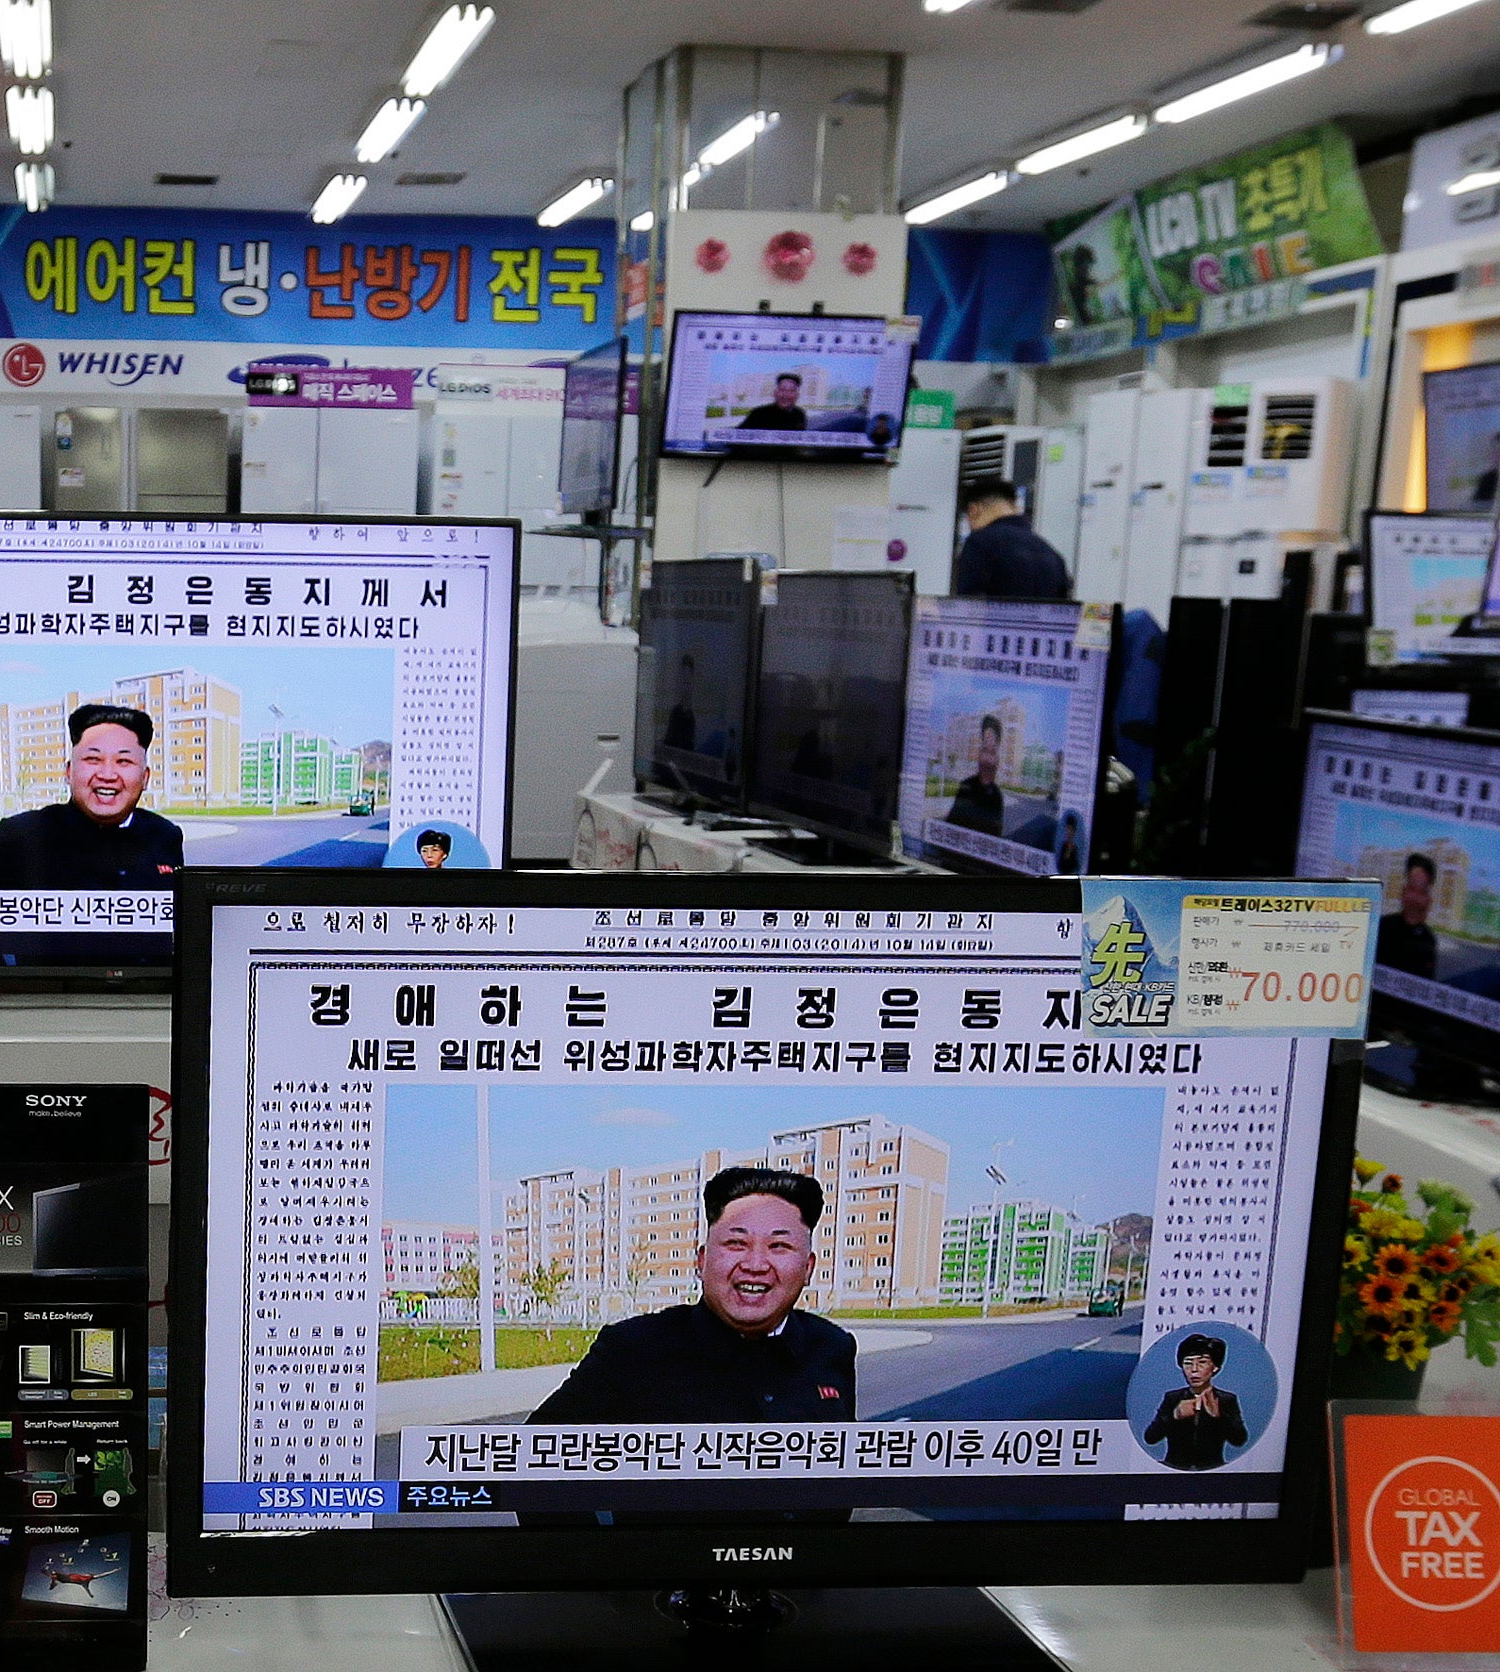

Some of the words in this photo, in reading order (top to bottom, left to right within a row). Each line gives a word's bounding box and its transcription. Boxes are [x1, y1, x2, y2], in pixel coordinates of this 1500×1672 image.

[25, 236, 196, 316] 에어컨
[488, 246, 604, 324] 전국
[58, 352, 184, 386] WHISEN
[226, 614, 420, 640] 현지지도하시였다
[1090, 921, 1146, 989] 先
[712, 986, 1082, 1031] 김정은동지
[1088, 993, 1176, 1027] SALE
[347, 1040, 417, 1073] 새로
[439, 1040, 542, 1073] 일떠선
[563, 1040, 911, 1075] 위성과학자주택지구를
[933, 1041, 1203, 1075] 현지지도하시였다
[25, 1094, 88, 1107] SONY
[29, 1110, 82, 1118] make.believe
[23, 1311, 41, 1321] Slim
[49, 1311, 94, 1322] Eco-friendly
[23, 1420, 47, 1430] Smart
[47, 1420, 71, 1430] Power
[72, 1420, 120, 1431] Management
[425, 1431, 520, 1472] 지난달
[527, 1431, 684, 1472] 모란봉악단
[691, 1430, 847, 1471] 신작음악회
[855, 1429, 917, 1470] 관람
[924, 1429, 985, 1470] 이후
[990, 1428, 1063, 1469] 40일
[1071, 1427, 1103, 1468] 만
[257, 1486, 304, 1510] SBS
[311, 1487, 384, 1510] NEWS
[407, 1484, 493, 1507] 주요뉴스
[1398, 1488, 1482, 1506] GLOBAL
[24, 1525, 53, 1534] Smooth
[53, 1525, 80, 1534] Motion
[1395, 1510, 1484, 1547] TAX
[712, 1547, 794, 1562] TAESAN
[1402, 1551, 1486, 1579] FREE
